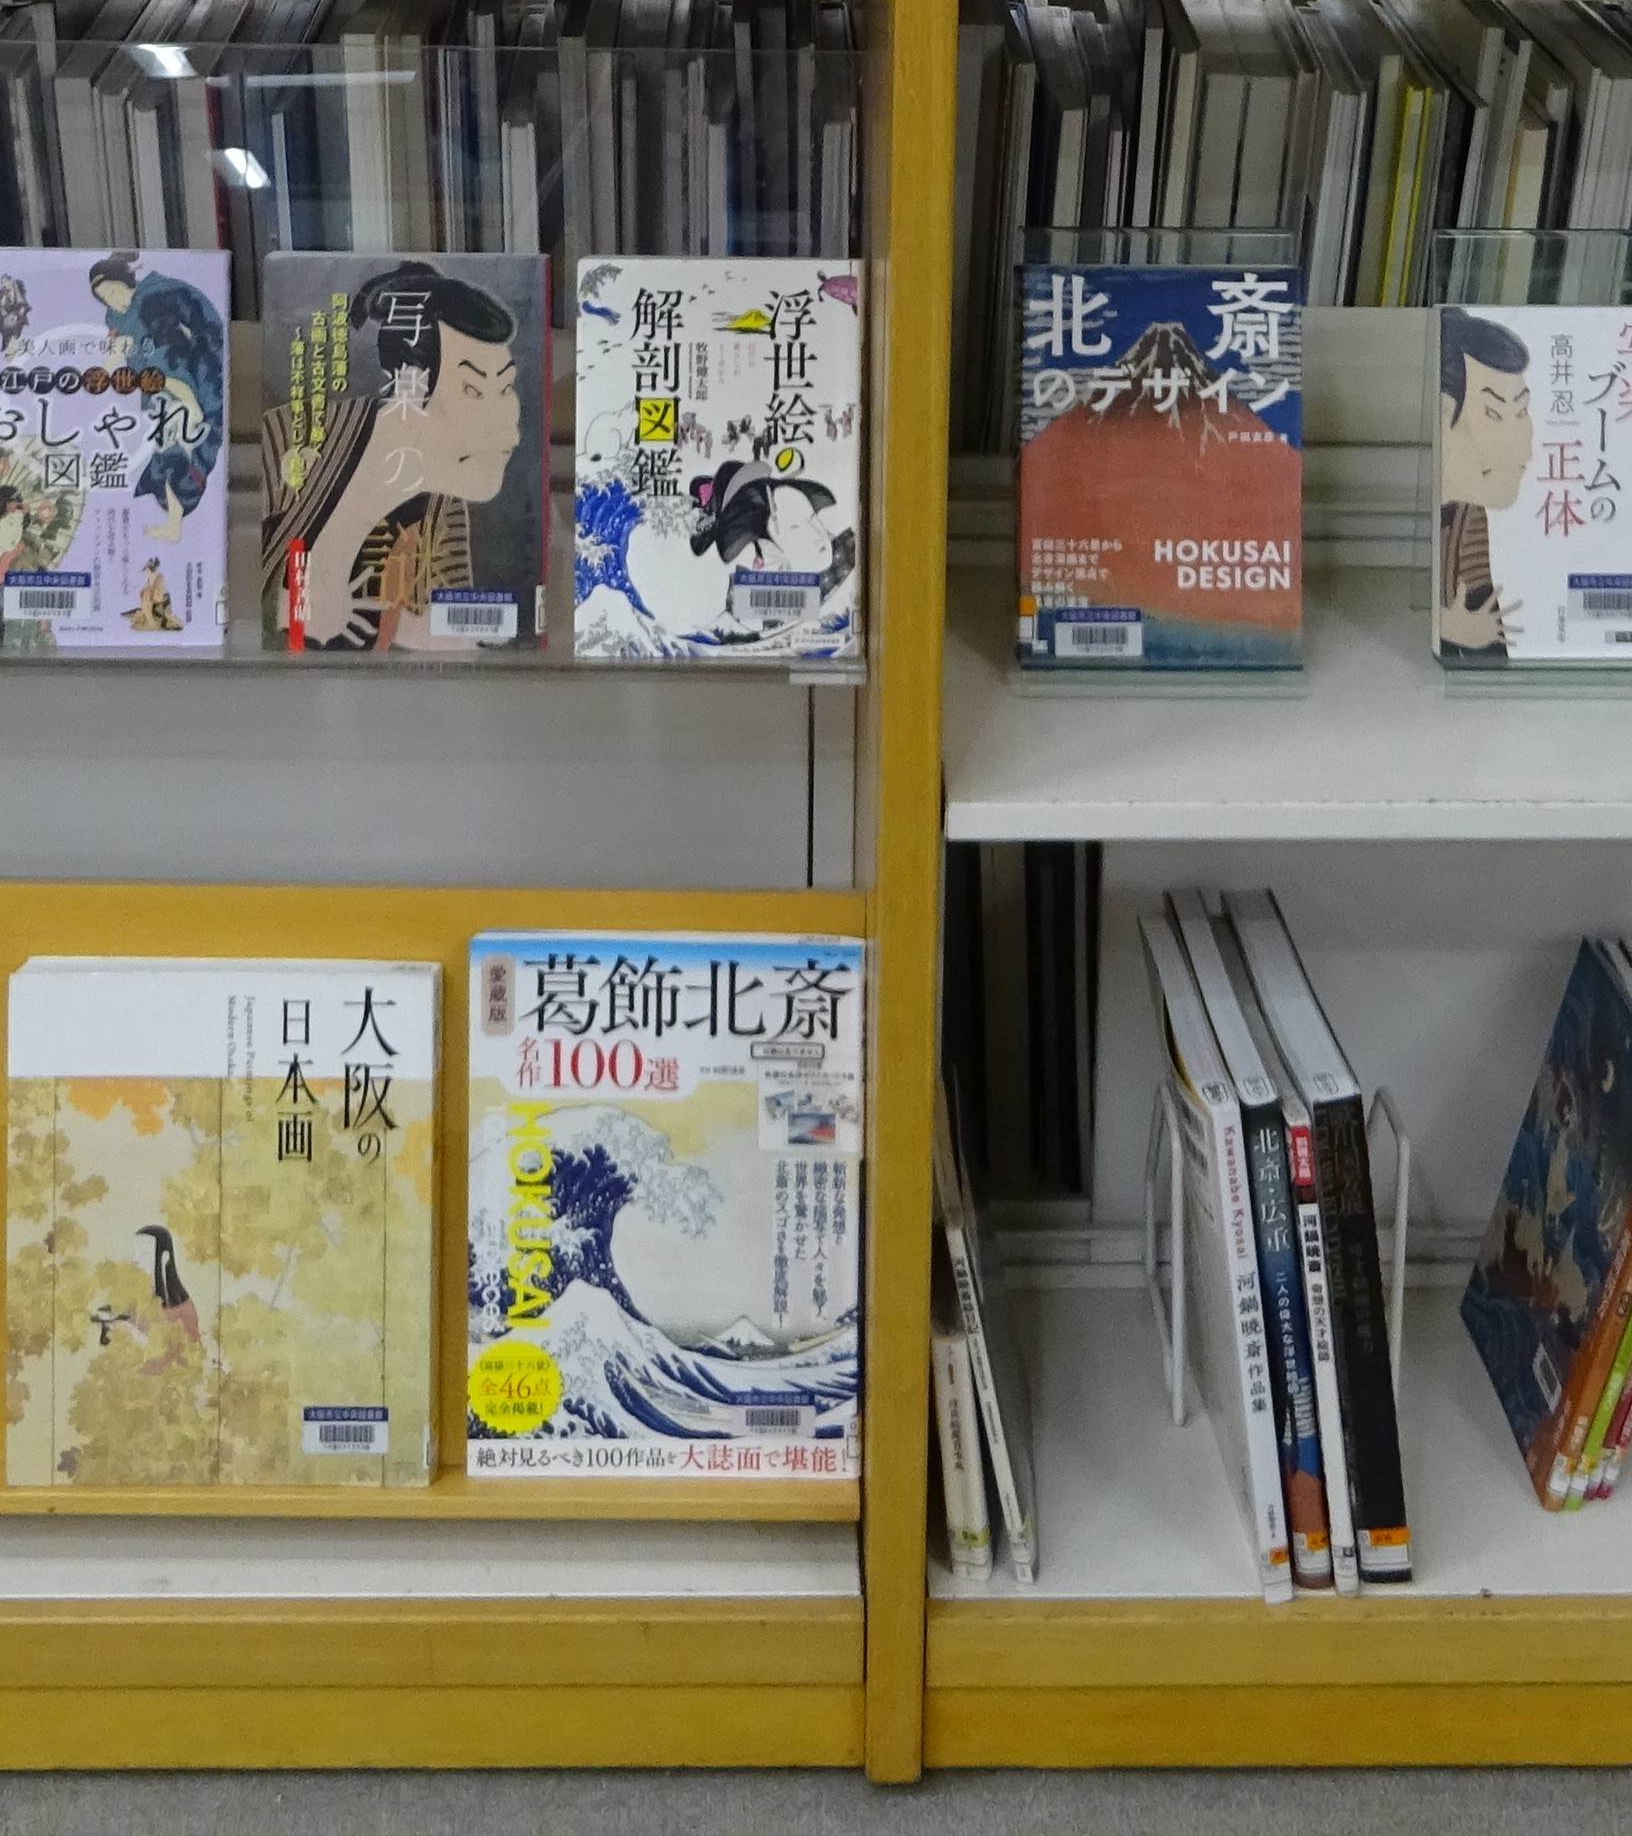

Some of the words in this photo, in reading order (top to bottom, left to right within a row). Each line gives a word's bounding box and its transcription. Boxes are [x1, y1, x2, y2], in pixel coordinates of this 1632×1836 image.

[1025, 272, 1296, 362] 北斎
[0, 366, 166, 395] 江戸の浮世絵
[377, 289, 433, 493] 写楽の
[629, 287, 685, 499] 解剖図鑑
[763, 289, 819, 475] 浮世絵の
[1032, 366, 1291, 415] のデザイン
[1549, 333, 1575, 415] 高井忍
[44, 451, 130, 490] 図鑑
[1583, 361, 1626, 525] ブームの
[1534, 439, 1587, 538] 正体
[1153, 539, 1292, 564] HOKUSAI
[1176, 565, 1292, 590] DESIGN
[519, 954, 857, 1042] 葛飾北斎
[275, 998, 321, 1164] 日本画
[340, 985, 401, 1165] 大阪の
[508, 1102, 553, 1328] HOKUSAI
[479, 1375, 551, 1402] 全46点
